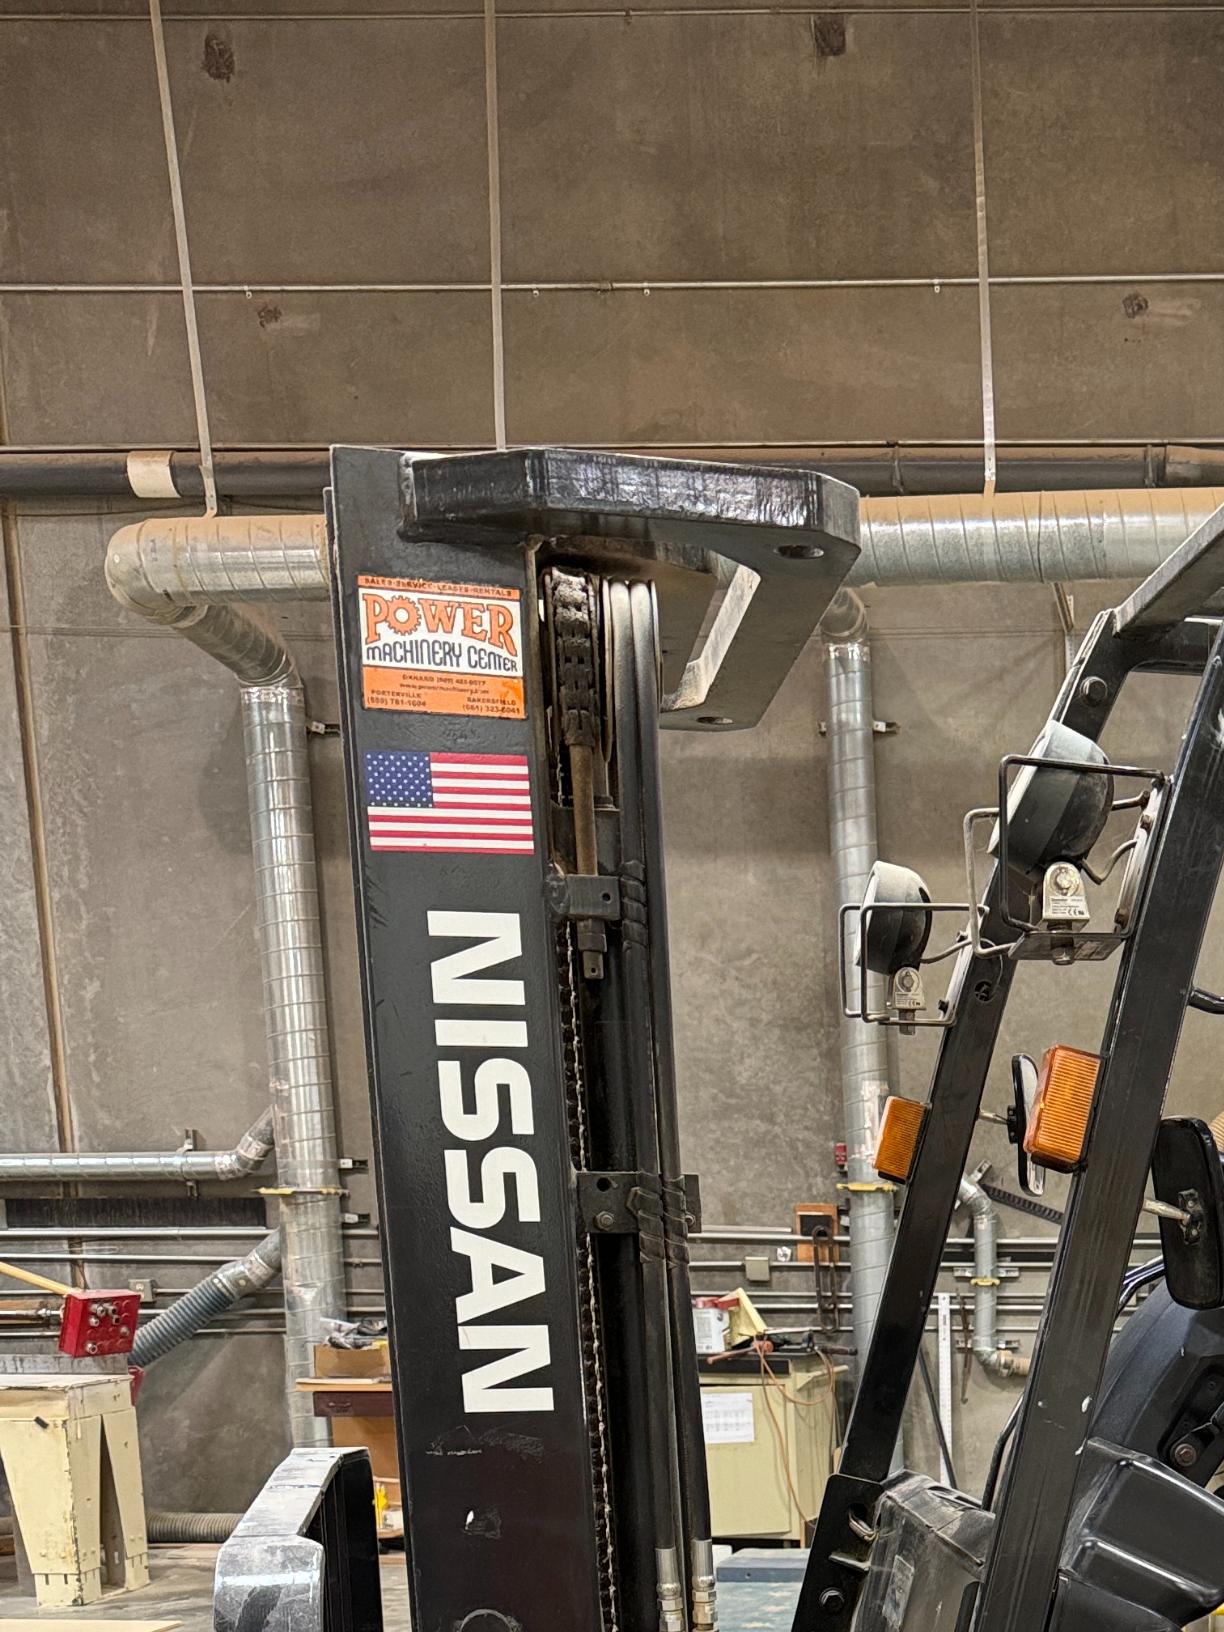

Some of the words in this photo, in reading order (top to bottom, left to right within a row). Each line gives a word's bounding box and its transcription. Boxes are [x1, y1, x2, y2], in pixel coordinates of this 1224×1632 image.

[362, 593, 518, 657] POWER
[366, 639, 462, 668] MACHINERY
[468, 645, 518, 672] CENTER
[426, 910, 554, 1413] NISSAN
